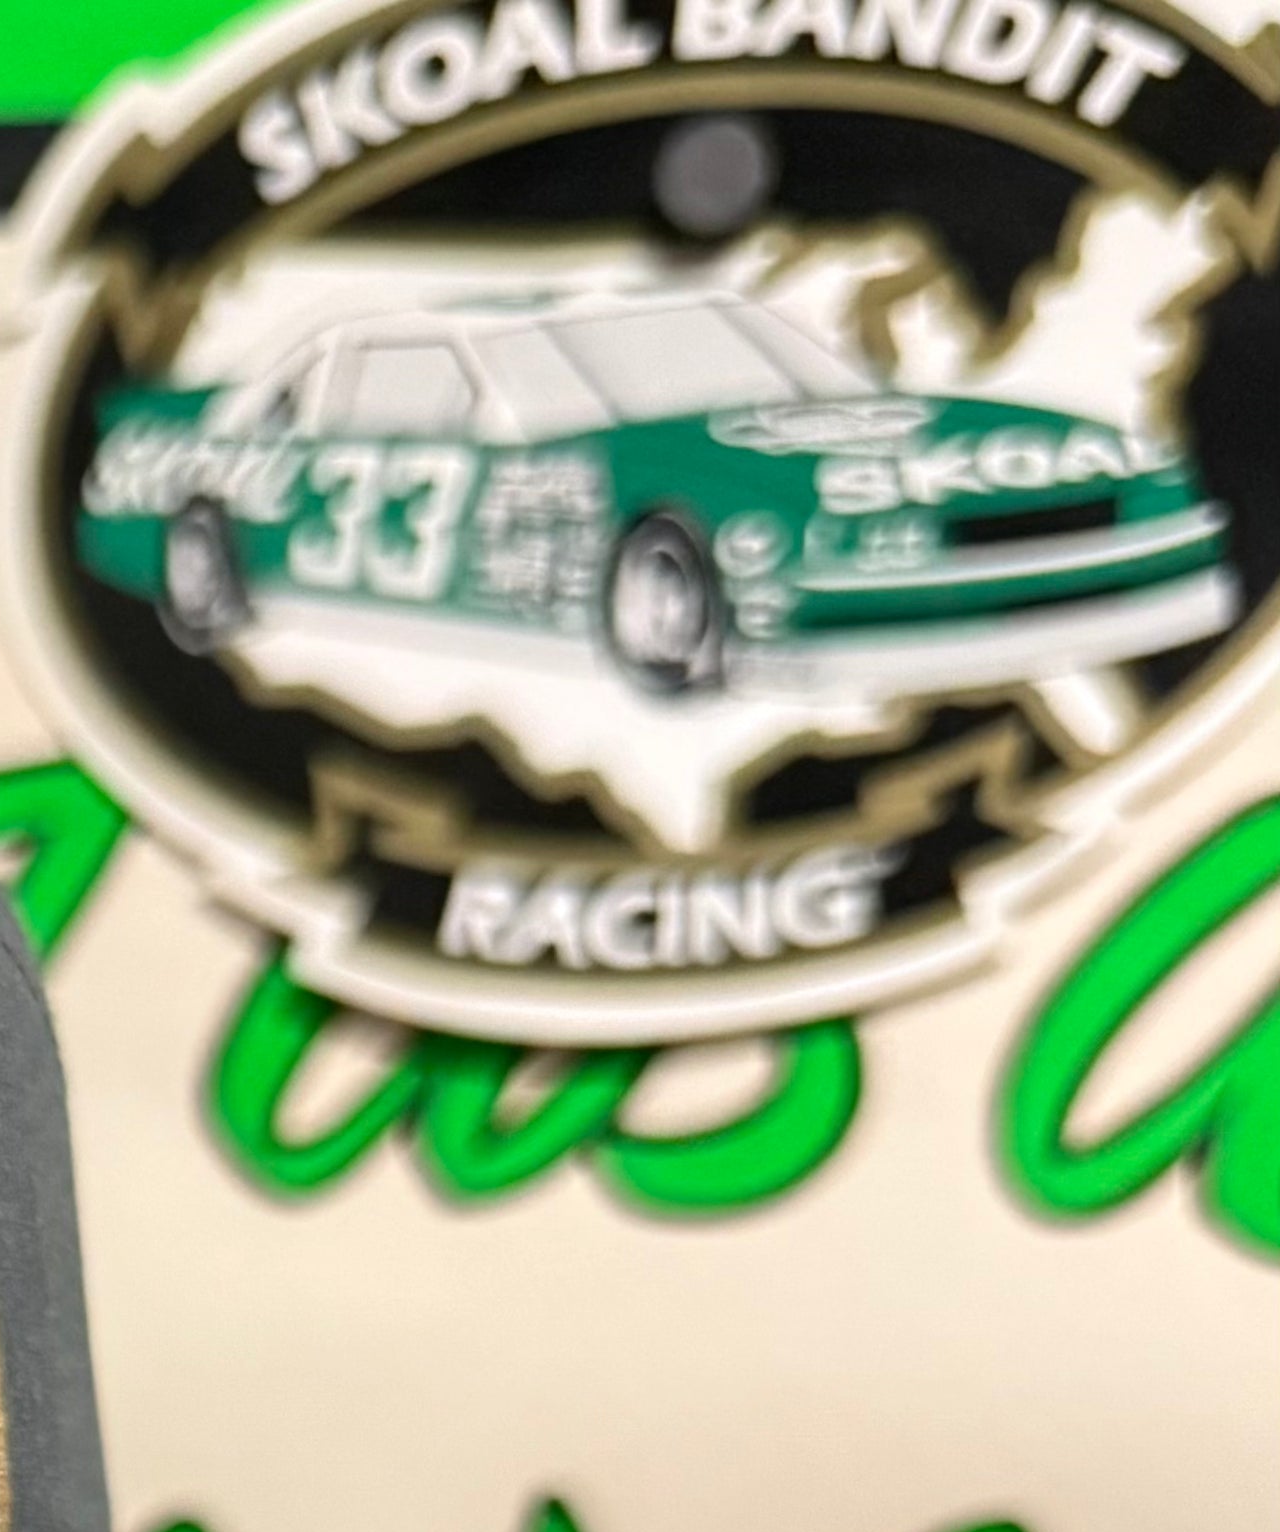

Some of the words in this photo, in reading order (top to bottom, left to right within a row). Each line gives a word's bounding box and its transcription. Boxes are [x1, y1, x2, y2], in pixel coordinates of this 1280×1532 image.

[239, 0, 658, 203] SKOAL
[671, 0, 1187, 127] BANDIT
[288, 438, 478, 602] 33
[812, 408, 1182, 516] SKOAL
[438, 843, 902, 970] RACING
